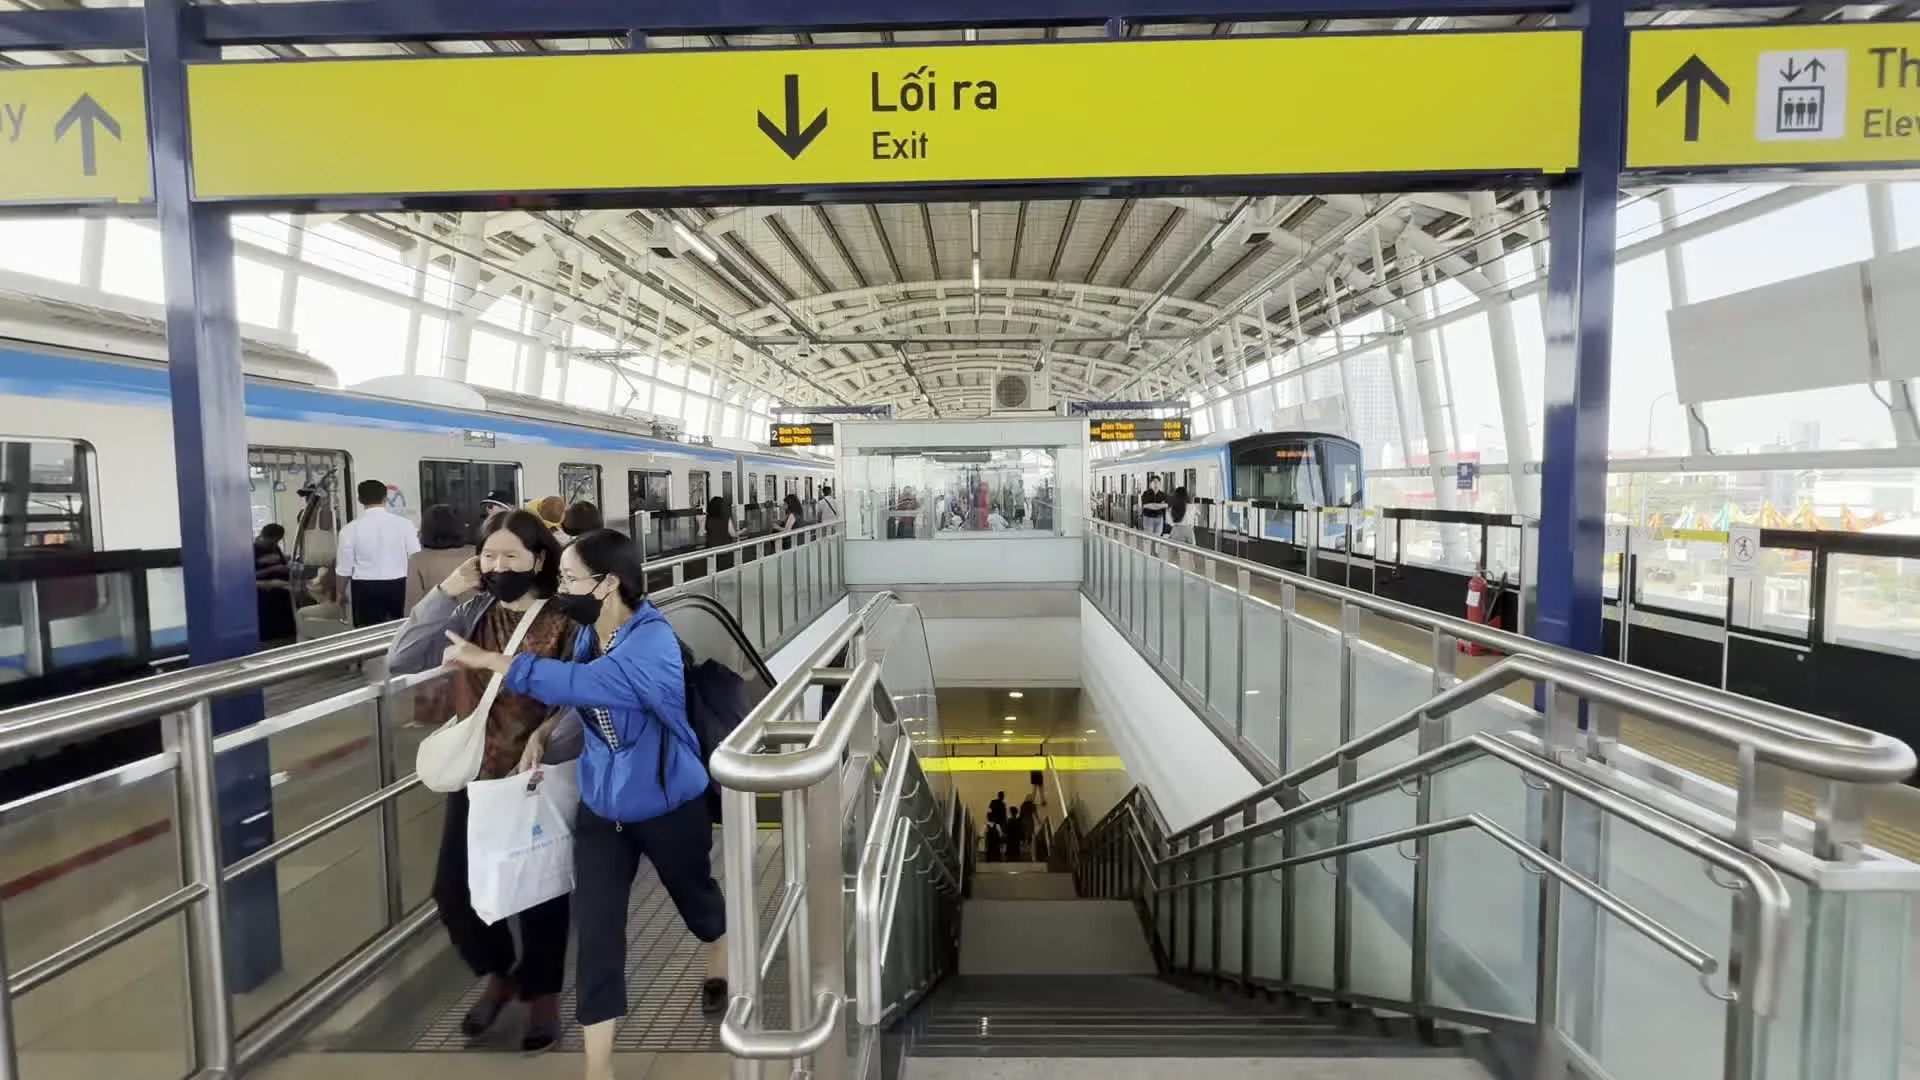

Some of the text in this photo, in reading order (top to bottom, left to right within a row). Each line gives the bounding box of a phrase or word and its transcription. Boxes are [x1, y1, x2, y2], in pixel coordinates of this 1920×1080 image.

[871, 65, 997, 112] Lối ra
[0, 103, 27, 143] y
[872, 130, 929, 160] Exit
[771, 430, 778, 441] 2
[1183, 423, 1189, 435] 1
